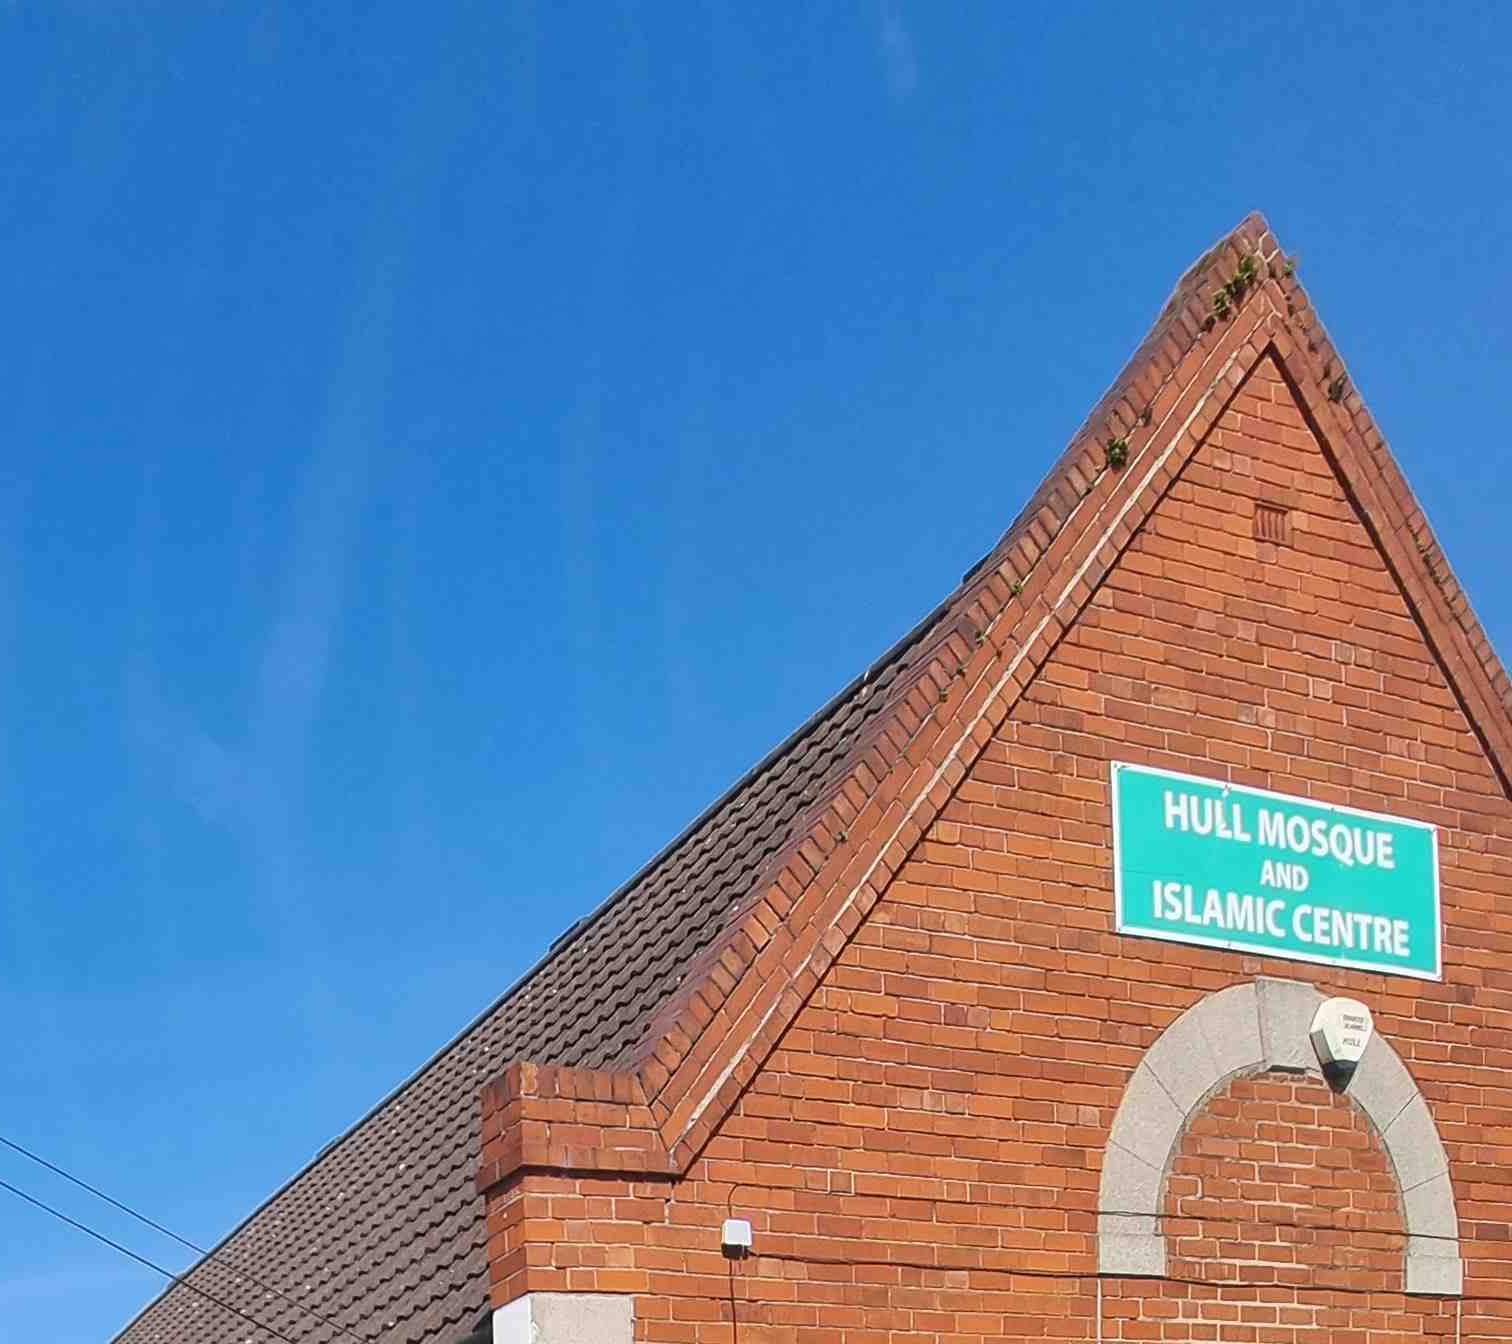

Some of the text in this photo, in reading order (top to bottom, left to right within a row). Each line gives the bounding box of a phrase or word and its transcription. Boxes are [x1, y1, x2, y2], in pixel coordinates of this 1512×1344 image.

[1163, 790, 1397, 870] HULL MOSQUE
[1260, 859, 1310, 892] AND
[1152, 879, 1411, 958] ISLAMIC CENTRE
